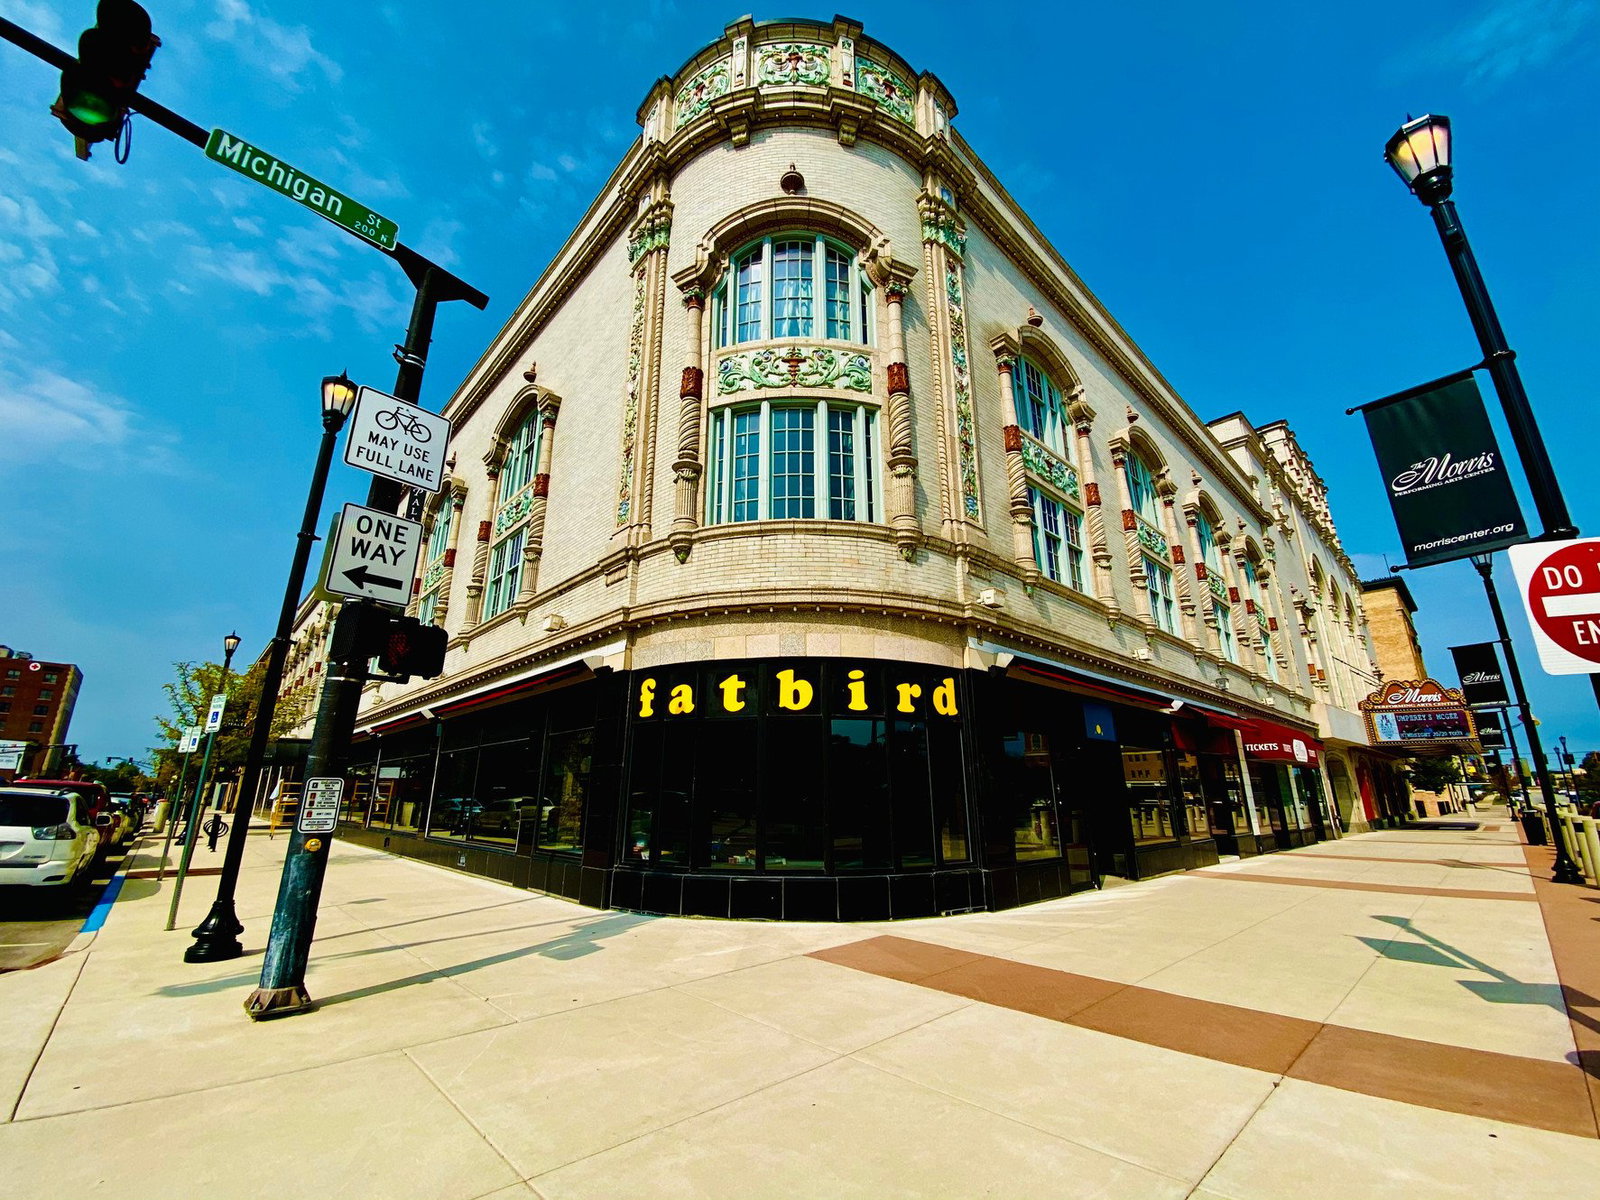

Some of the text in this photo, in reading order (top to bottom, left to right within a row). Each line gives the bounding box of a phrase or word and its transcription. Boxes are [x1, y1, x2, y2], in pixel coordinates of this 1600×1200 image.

[216, 132, 382, 229] Michigan St
[354, 220, 389, 243] 200 N
[367, 430, 430, 463] MAY USE
[356, 445, 434, 482] FULL LANE
[1391, 452, 1494, 491] Morris
[1410, 461, 1426, 471] The
[1394, 466, 1496, 497] PERFORMING ARTS CENTER
[356, 515, 409, 545] ONE
[1414, 522, 1515, 552] morriscenter.org
[351, 536, 406, 567] WAY
[1542, 565, 1583, 590] DO
[639, 669, 959, 717] fat bird
[1387, 687, 1442, 704] Morris
[1245, 743, 1279, 751] TICKETS
